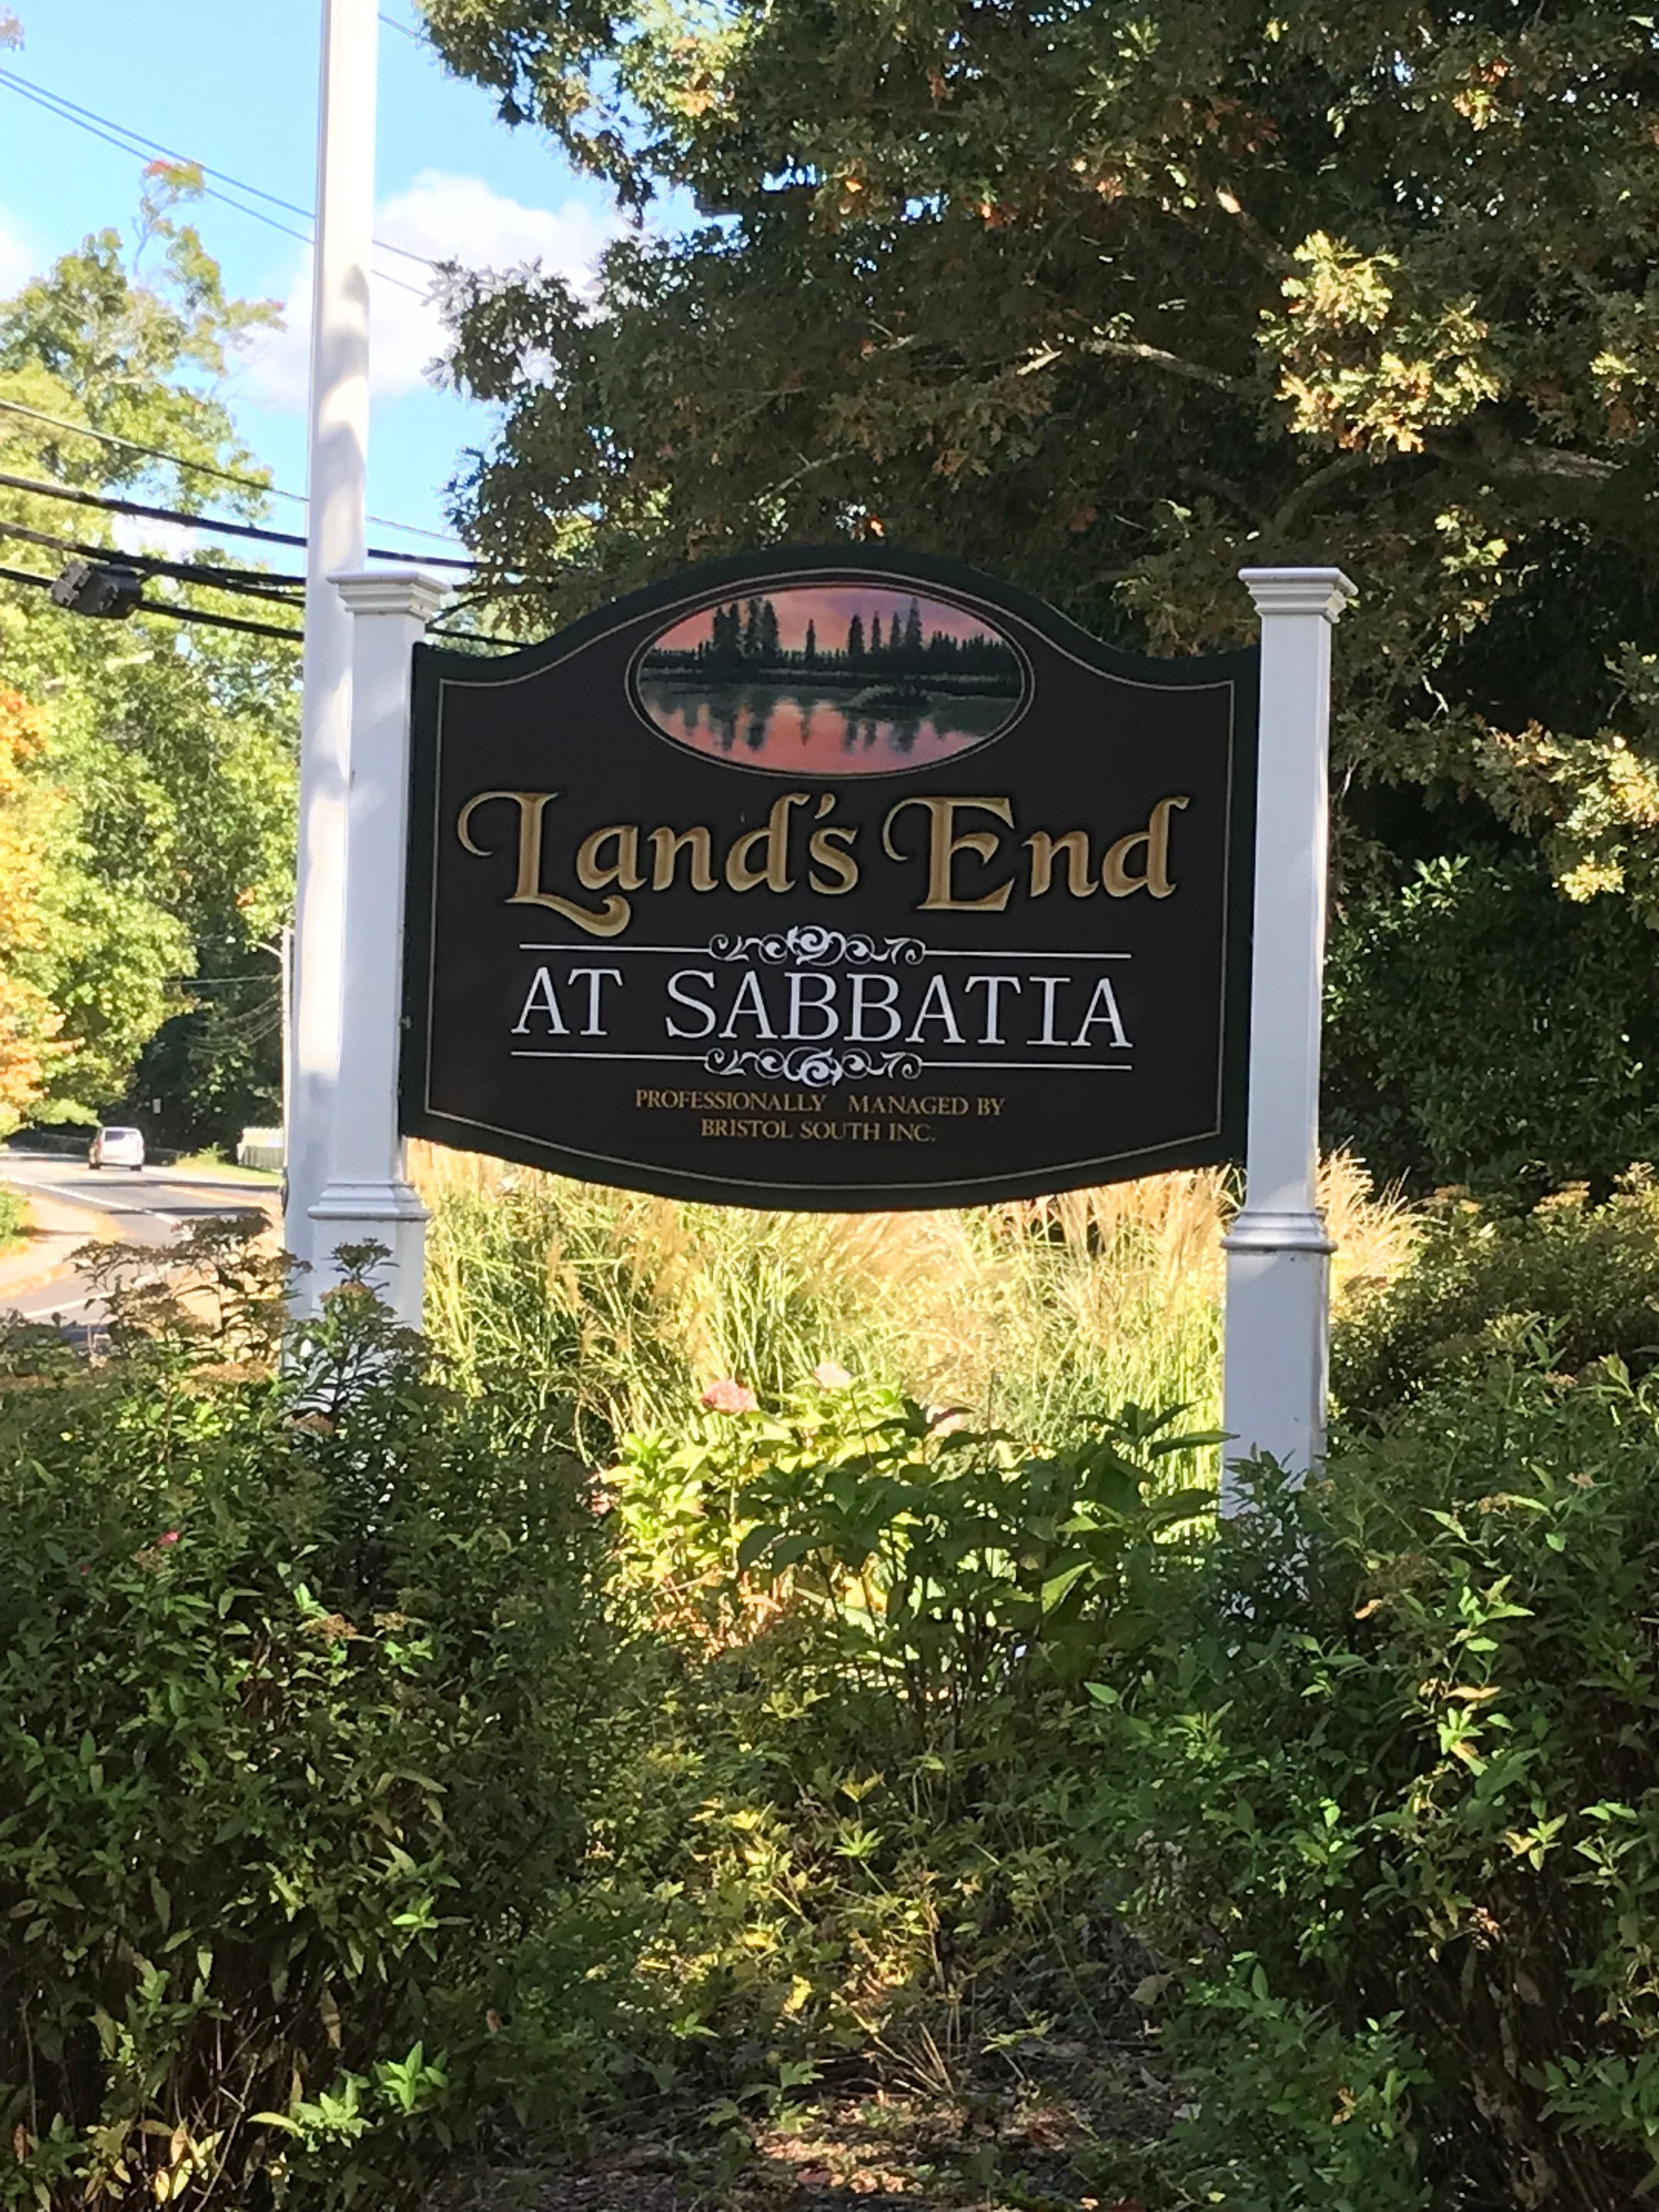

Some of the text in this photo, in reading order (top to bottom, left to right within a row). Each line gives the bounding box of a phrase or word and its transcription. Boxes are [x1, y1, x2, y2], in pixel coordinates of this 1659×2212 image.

[457, 792, 1190, 937] Land's End
[510, 967, 1133, 1048] AT SABBATIA
[635, 1089, 1005, 1116] PROFESSIONALLY MANAGED BY
[701, 1119, 936, 1142] BRISTOL SOUTH INC.
